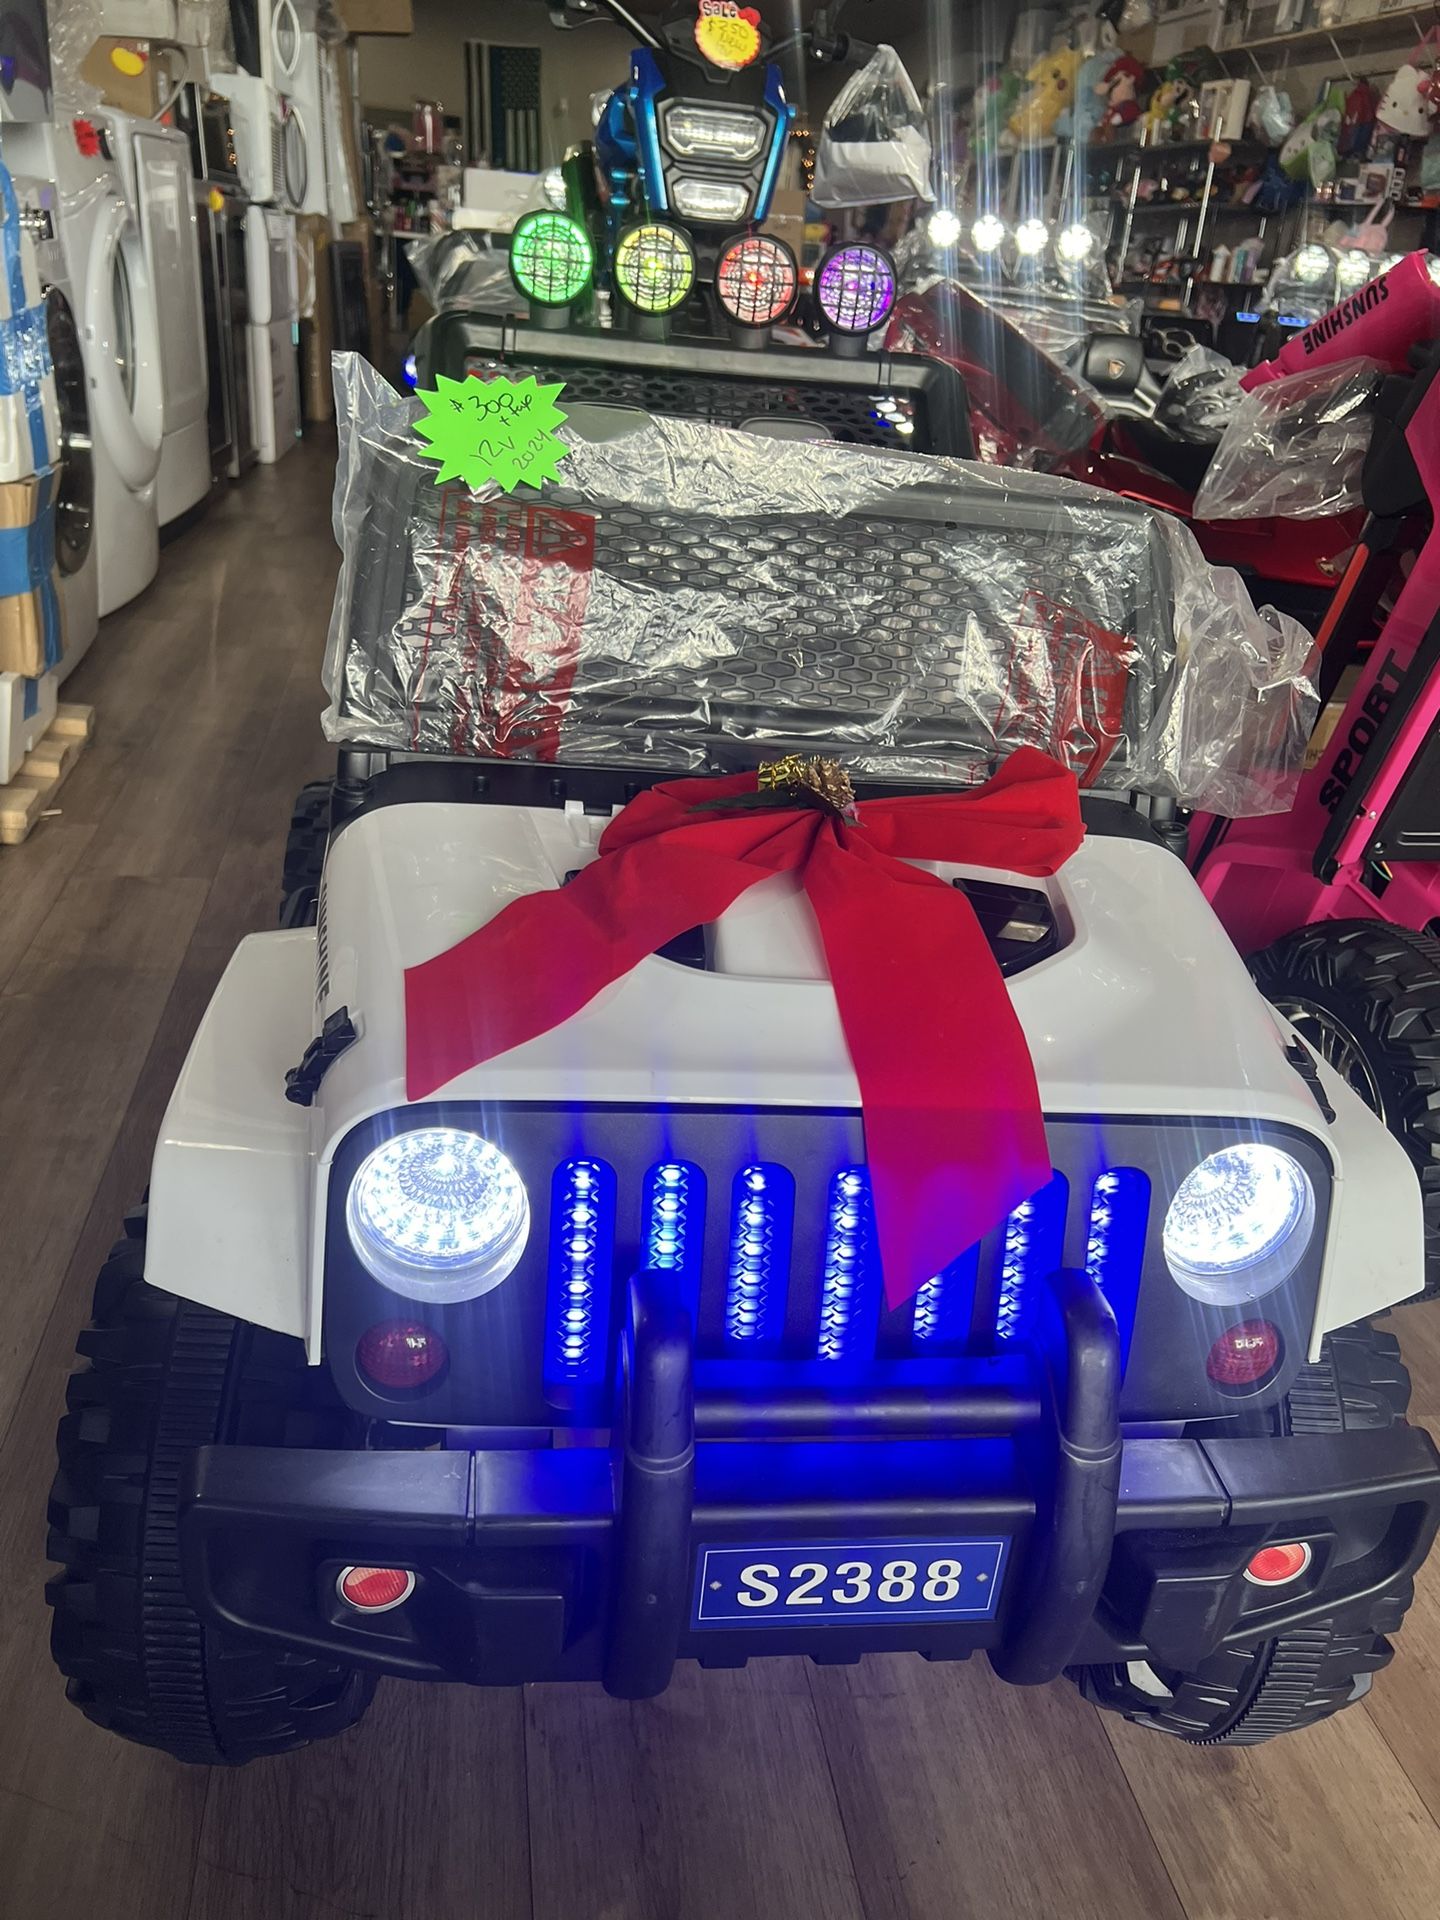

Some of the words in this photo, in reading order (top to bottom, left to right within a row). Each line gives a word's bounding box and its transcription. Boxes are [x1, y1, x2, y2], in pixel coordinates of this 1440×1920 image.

[1302, 275, 1389, 355] SUNSHINE
[511, 428, 553, 471] 2024
[1320, 648, 1408, 815] SPORT
[736, 1559, 963, 1607] S2388
